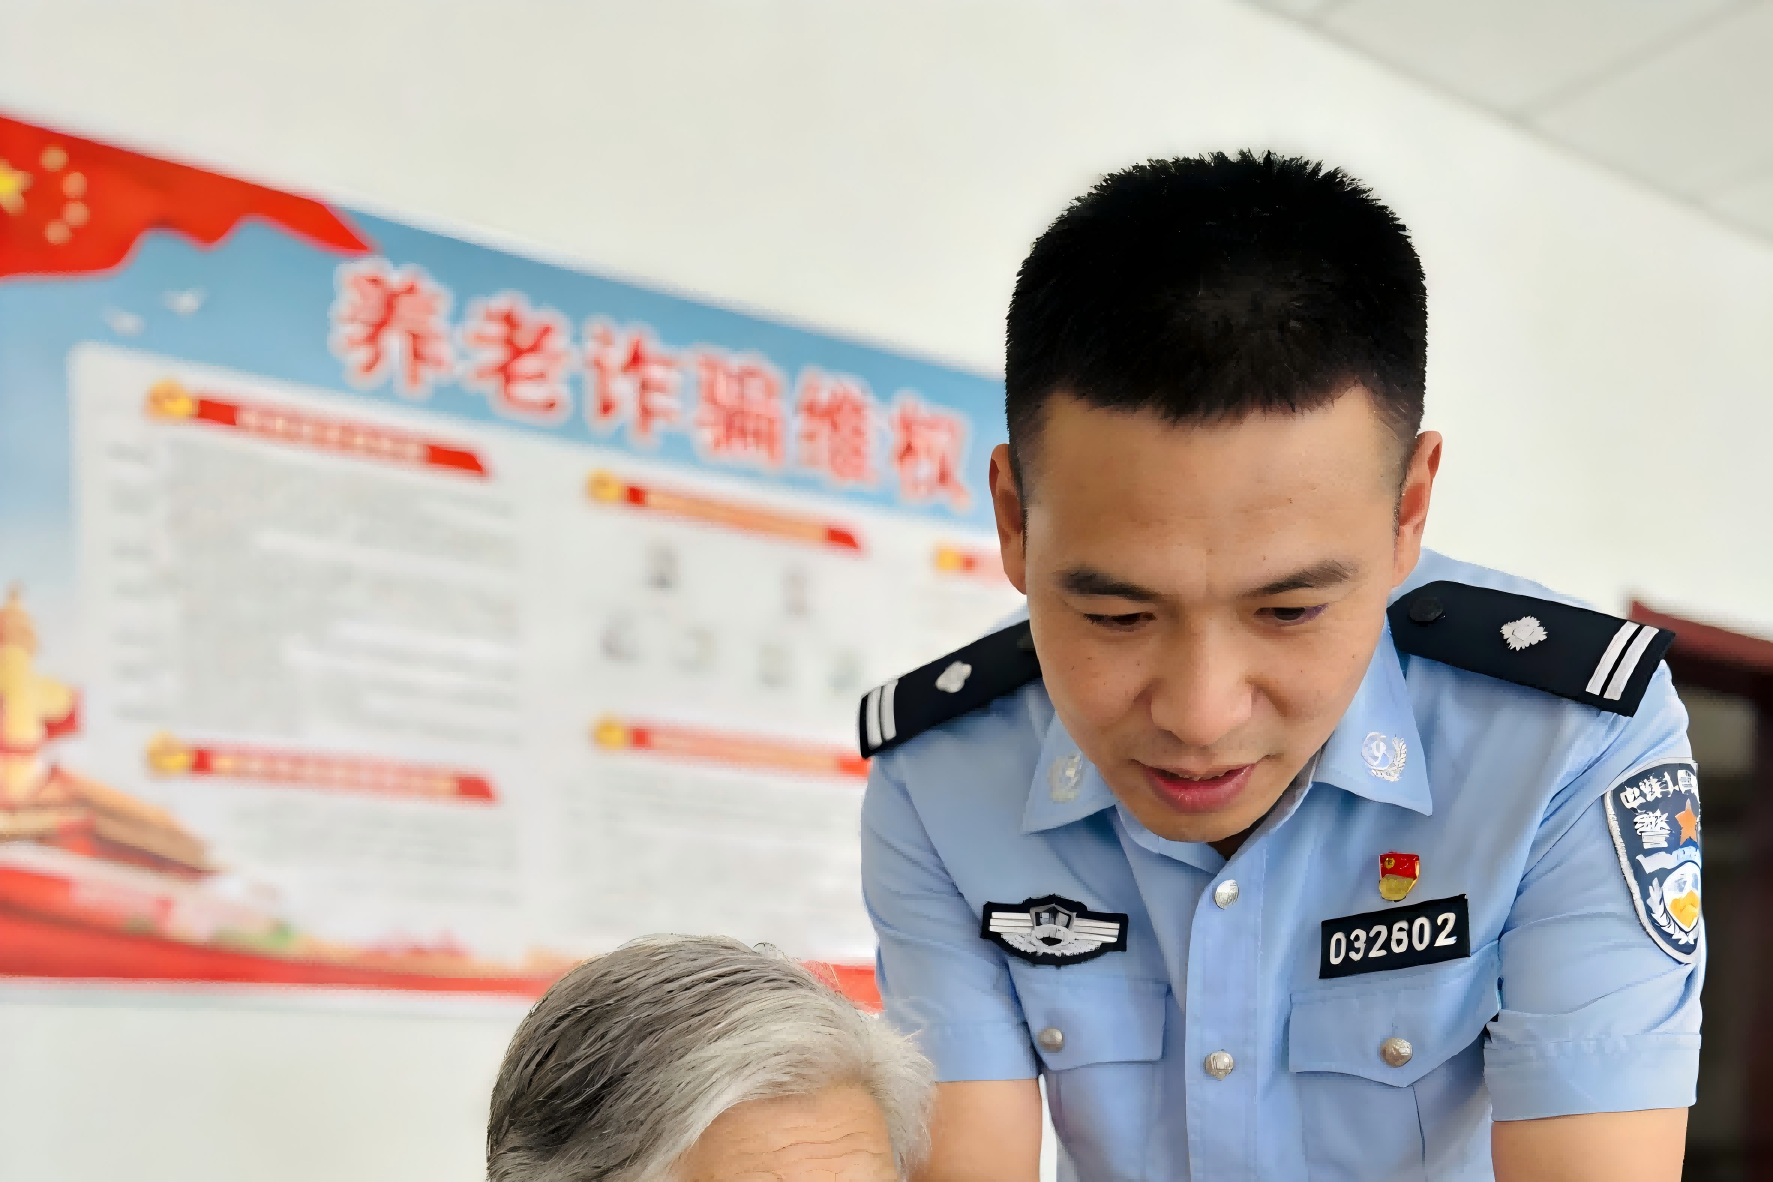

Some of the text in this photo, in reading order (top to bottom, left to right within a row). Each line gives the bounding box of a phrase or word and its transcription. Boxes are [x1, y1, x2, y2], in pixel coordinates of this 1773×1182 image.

[334, 266, 971, 511] 养老诈骗维权
[1329, 912, 1457, 965] 032602
